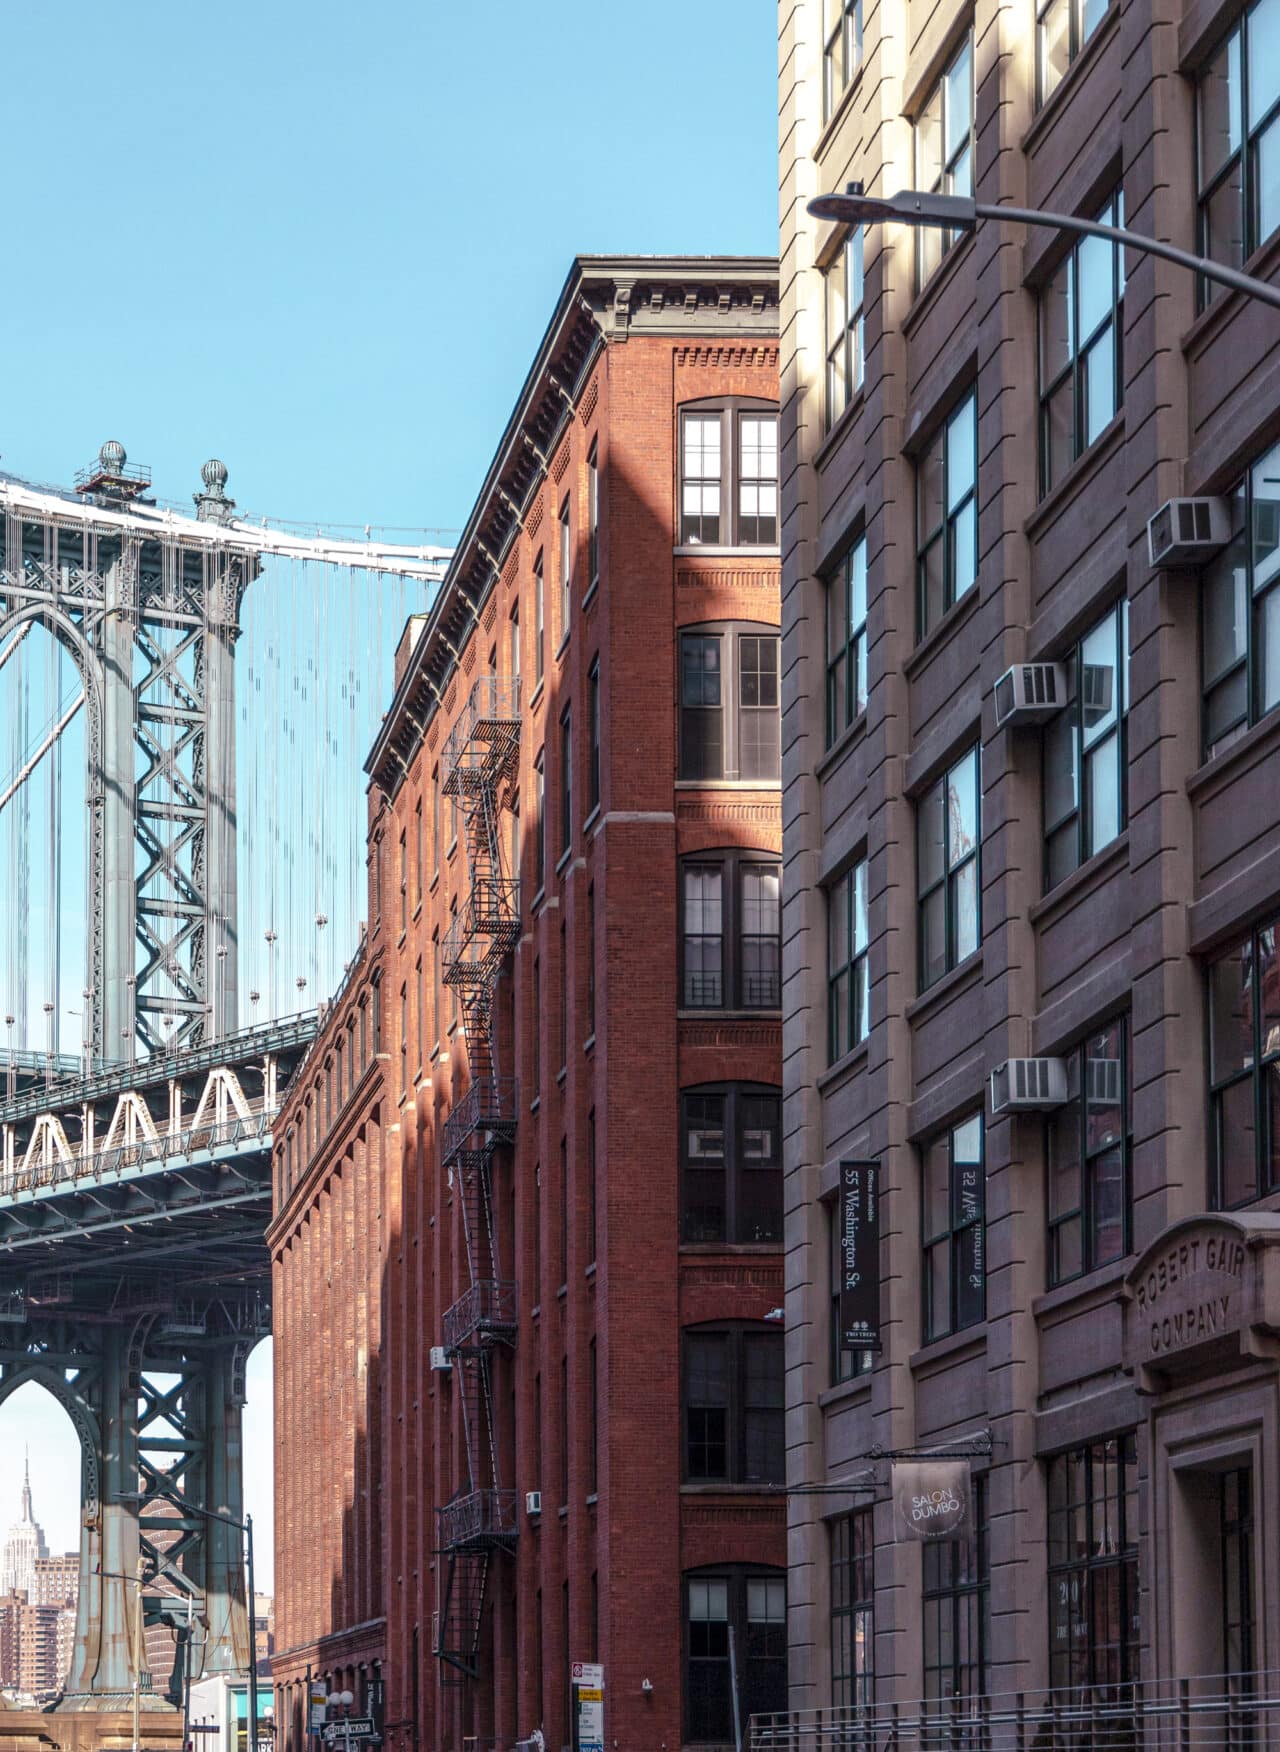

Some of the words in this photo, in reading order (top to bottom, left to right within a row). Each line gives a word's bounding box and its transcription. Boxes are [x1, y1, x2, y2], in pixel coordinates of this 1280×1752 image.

[845, 1169, 859, 1185] 55
[867, 1169, 875, 1192] Offices
[867, 1193, 875, 1222] Available
[842, 1188, 860, 1269] Washington
[846, 1271, 860, 1290] St.
[1138, 1240, 1200, 1312] ROBERT
[1206, 1238, 1245, 1277] GAIR
[1151, 1296, 1230, 1353] COMPANY
[912, 1488, 952, 1508] SALON
[912, 1499, 960, 1521] DUMBO
[328, 1726, 344, 1734] ONE
[351, 1724, 368, 1733] WAY
